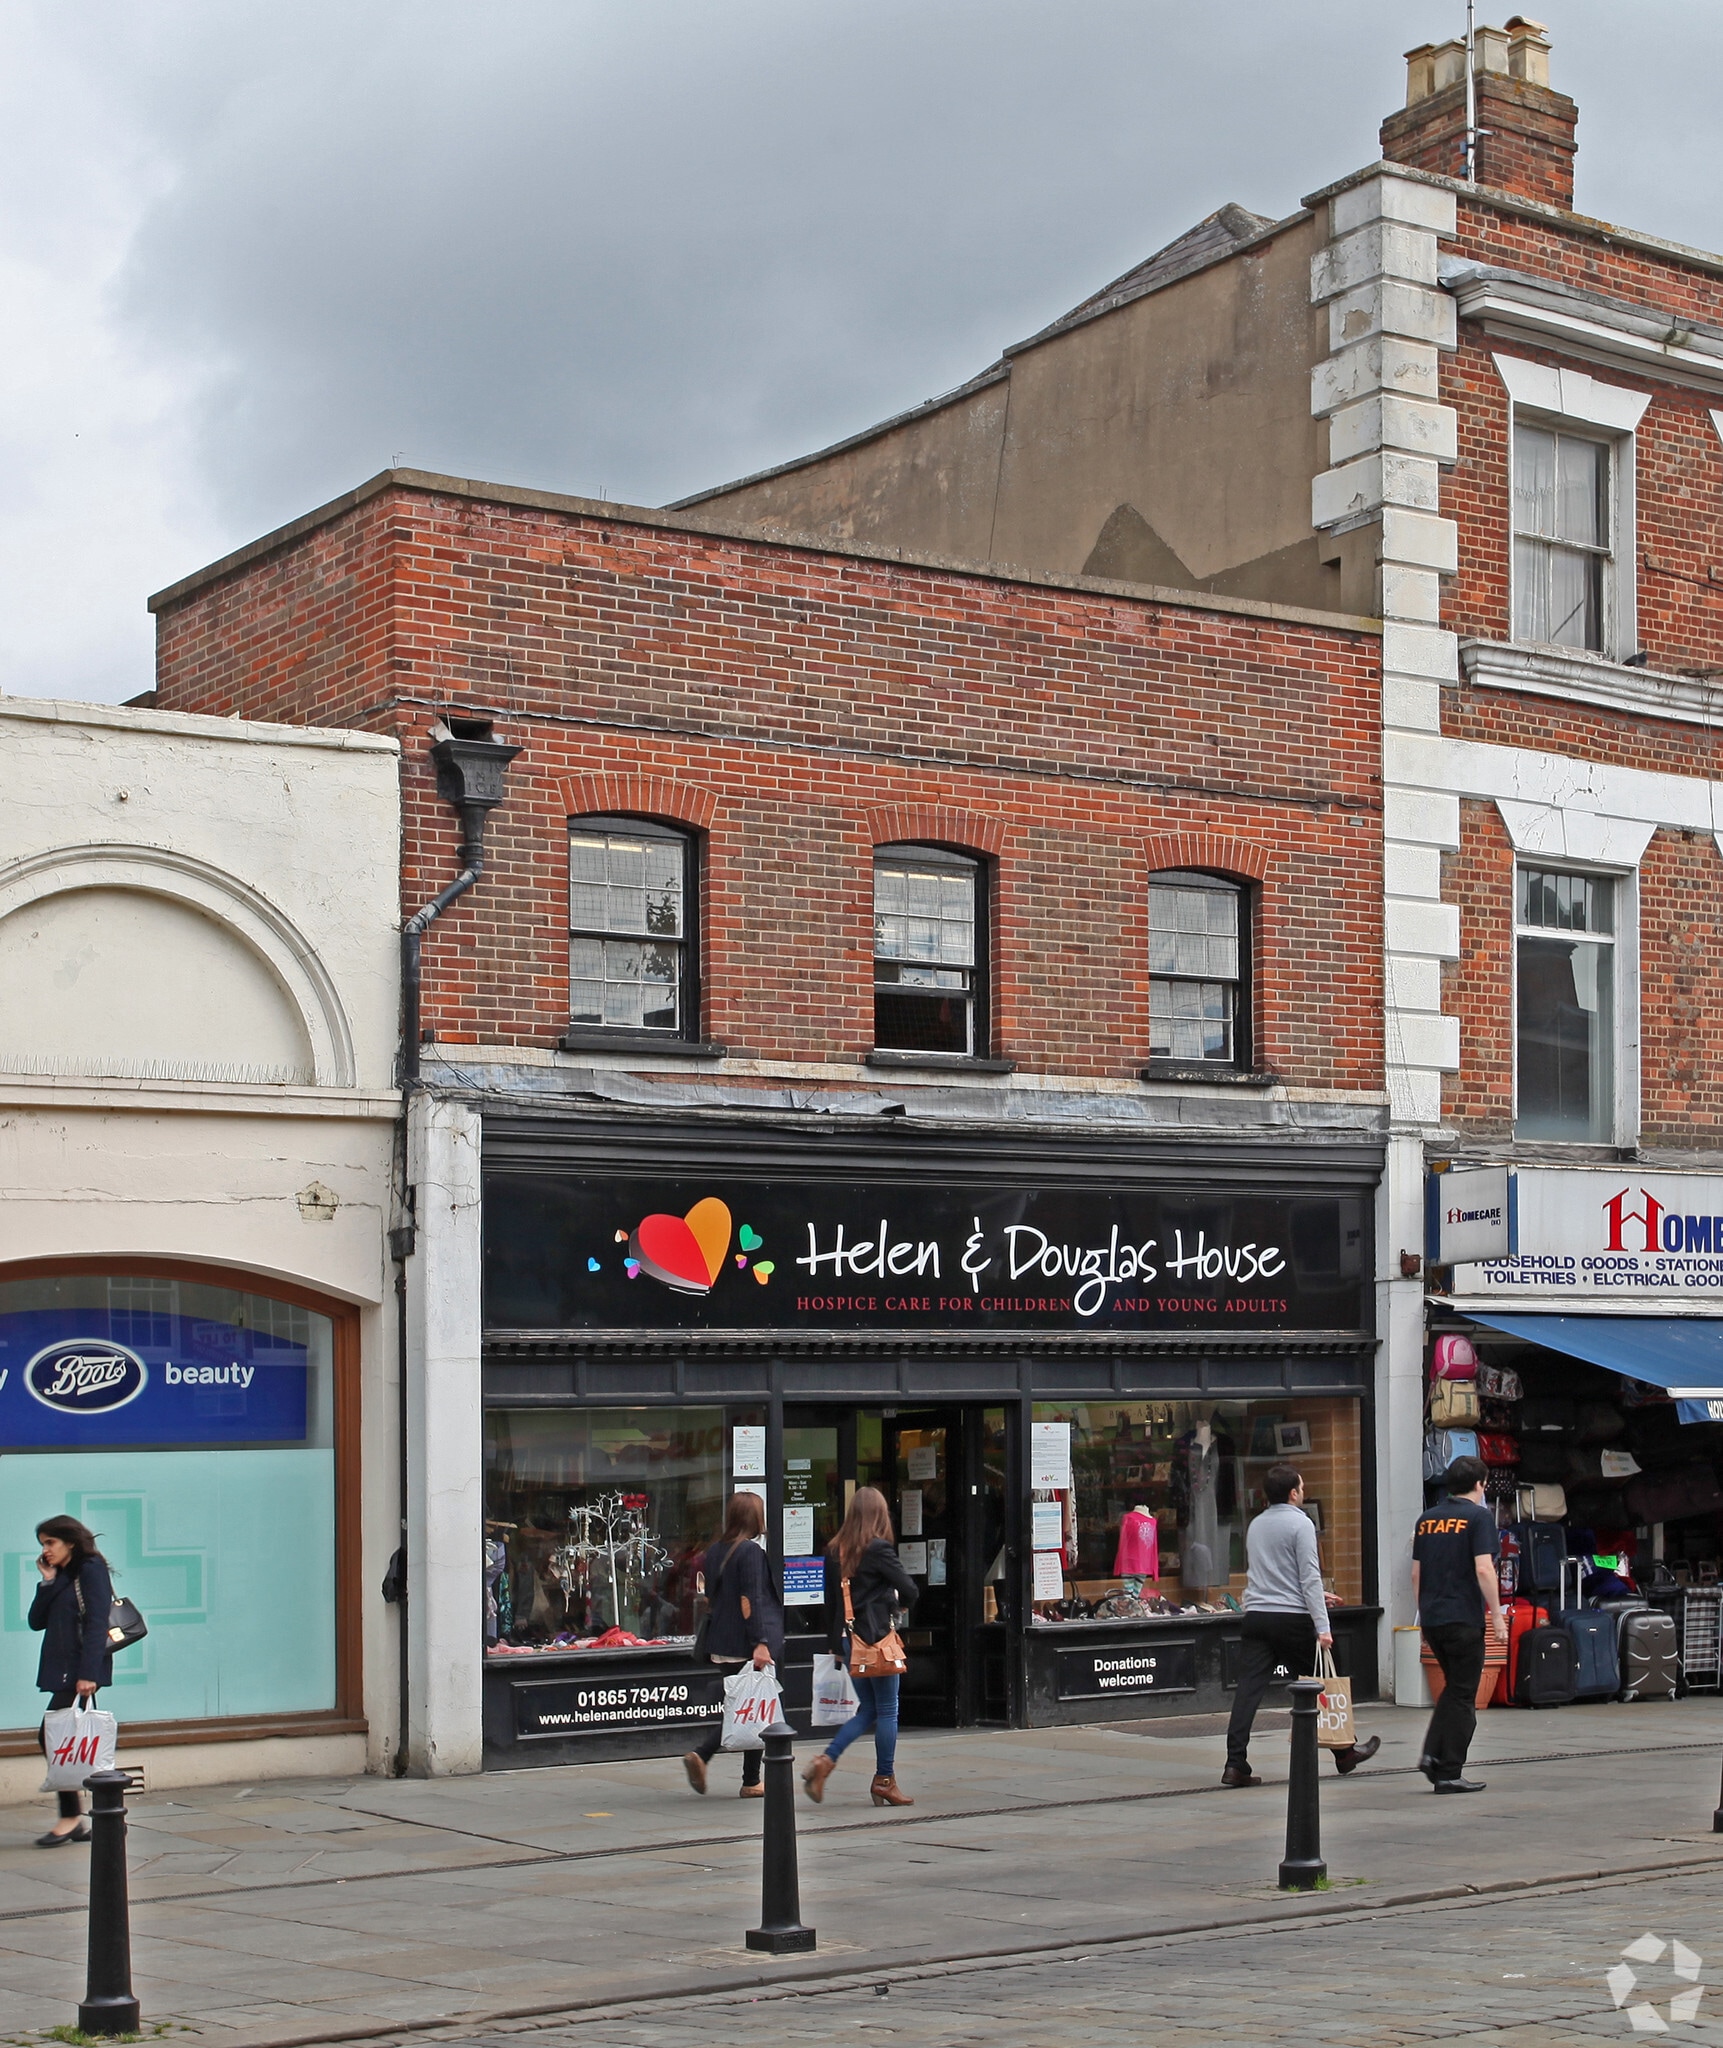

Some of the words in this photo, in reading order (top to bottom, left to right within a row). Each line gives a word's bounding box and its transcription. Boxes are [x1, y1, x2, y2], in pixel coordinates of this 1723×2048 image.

[1447, 1207, 1501, 1224] HOMECARE
[796, 1219, 940, 1278] Helen
[961, 1216, 992, 1293] &
[1003, 1224, 1157, 1316] Douglas
[1165, 1229, 1286, 1283] House
[1581, 1257, 1639, 1270] GOODS
[1483, 1271, 1577, 1285] TOILETRIES
[1593, 1272, 1680, 1287] ELCTRICAL
[797, 1297, 878, 1310] HOSPICE
[885, 1297, 931, 1311] CARE
[939, 1297, 974, 1311] FOR
[980, 1298, 1071, 1312] CHILDREN
[1112, 1299, 1150, 1312] AND
[1158, 1299, 1218, 1312] YOUNG
[1225, 1299, 1288, 1313] ADULTS
[44, 1355, 127, 1396] Boots
[165, 1361, 255, 1388] beauty
[1418, 1518, 1468, 1536] STAFF
[1094, 1656, 1157, 1672] Donations
[1098, 1673, 1154, 1688] welcome
[577, 1689, 627, 1707] 01865
[630, 1685, 688, 1704] 794749
[1326, 1693, 1347, 1710] TO
[539, 1702, 725, 1725] www.helenanddouglas.org.uk
[734, 1697, 777, 1725] H&M
[1317, 1711, 1348, 1730] HOP
[52, 1735, 101, 1767] H&M
